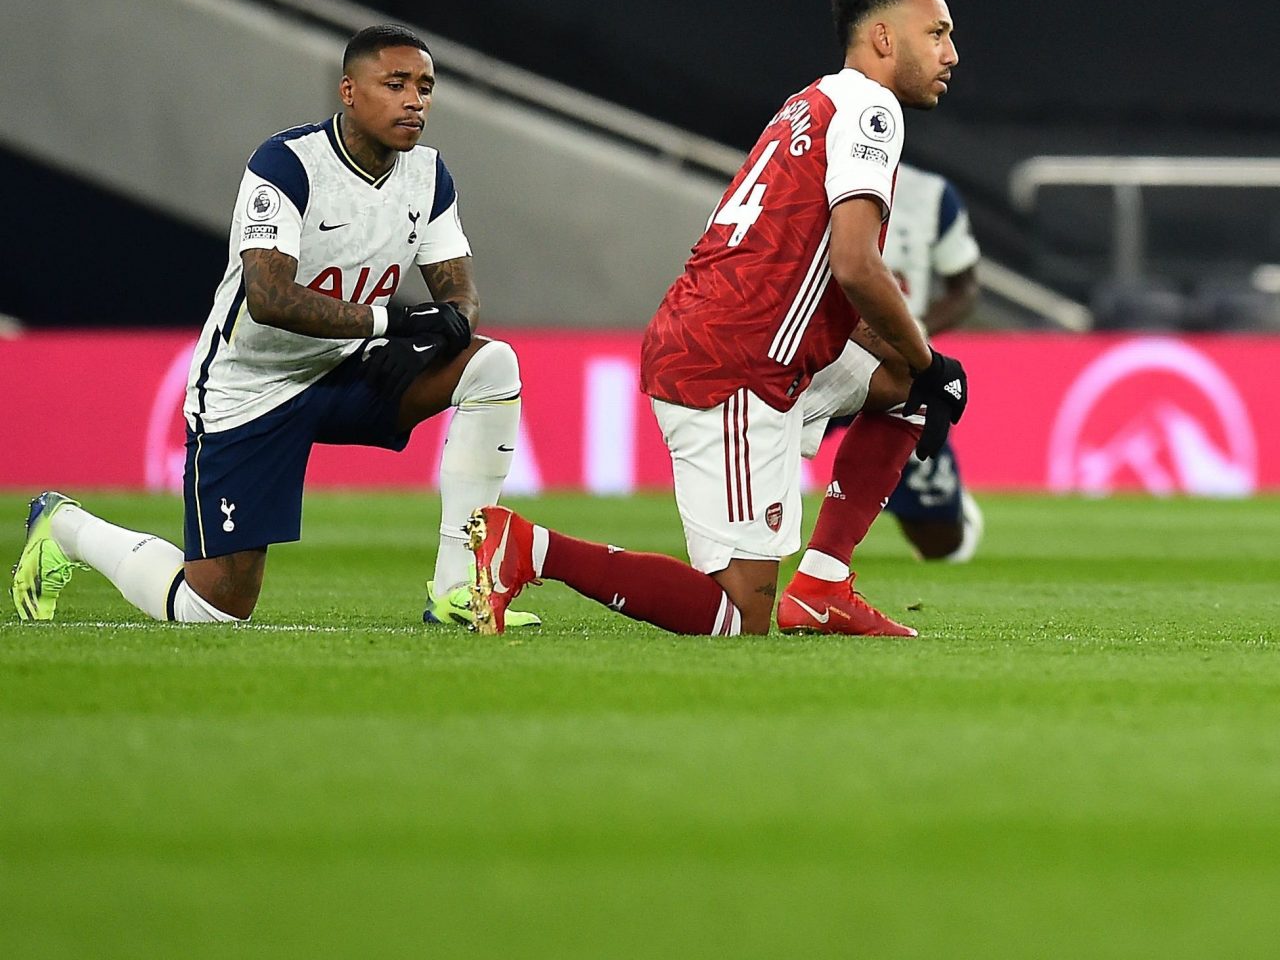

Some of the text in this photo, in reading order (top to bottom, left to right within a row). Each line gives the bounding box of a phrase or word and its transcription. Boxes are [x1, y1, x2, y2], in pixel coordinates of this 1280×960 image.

[866, 147, 888, 162] room
[705, 139, 768, 247] 4
[305, 263, 401, 306] AIA
